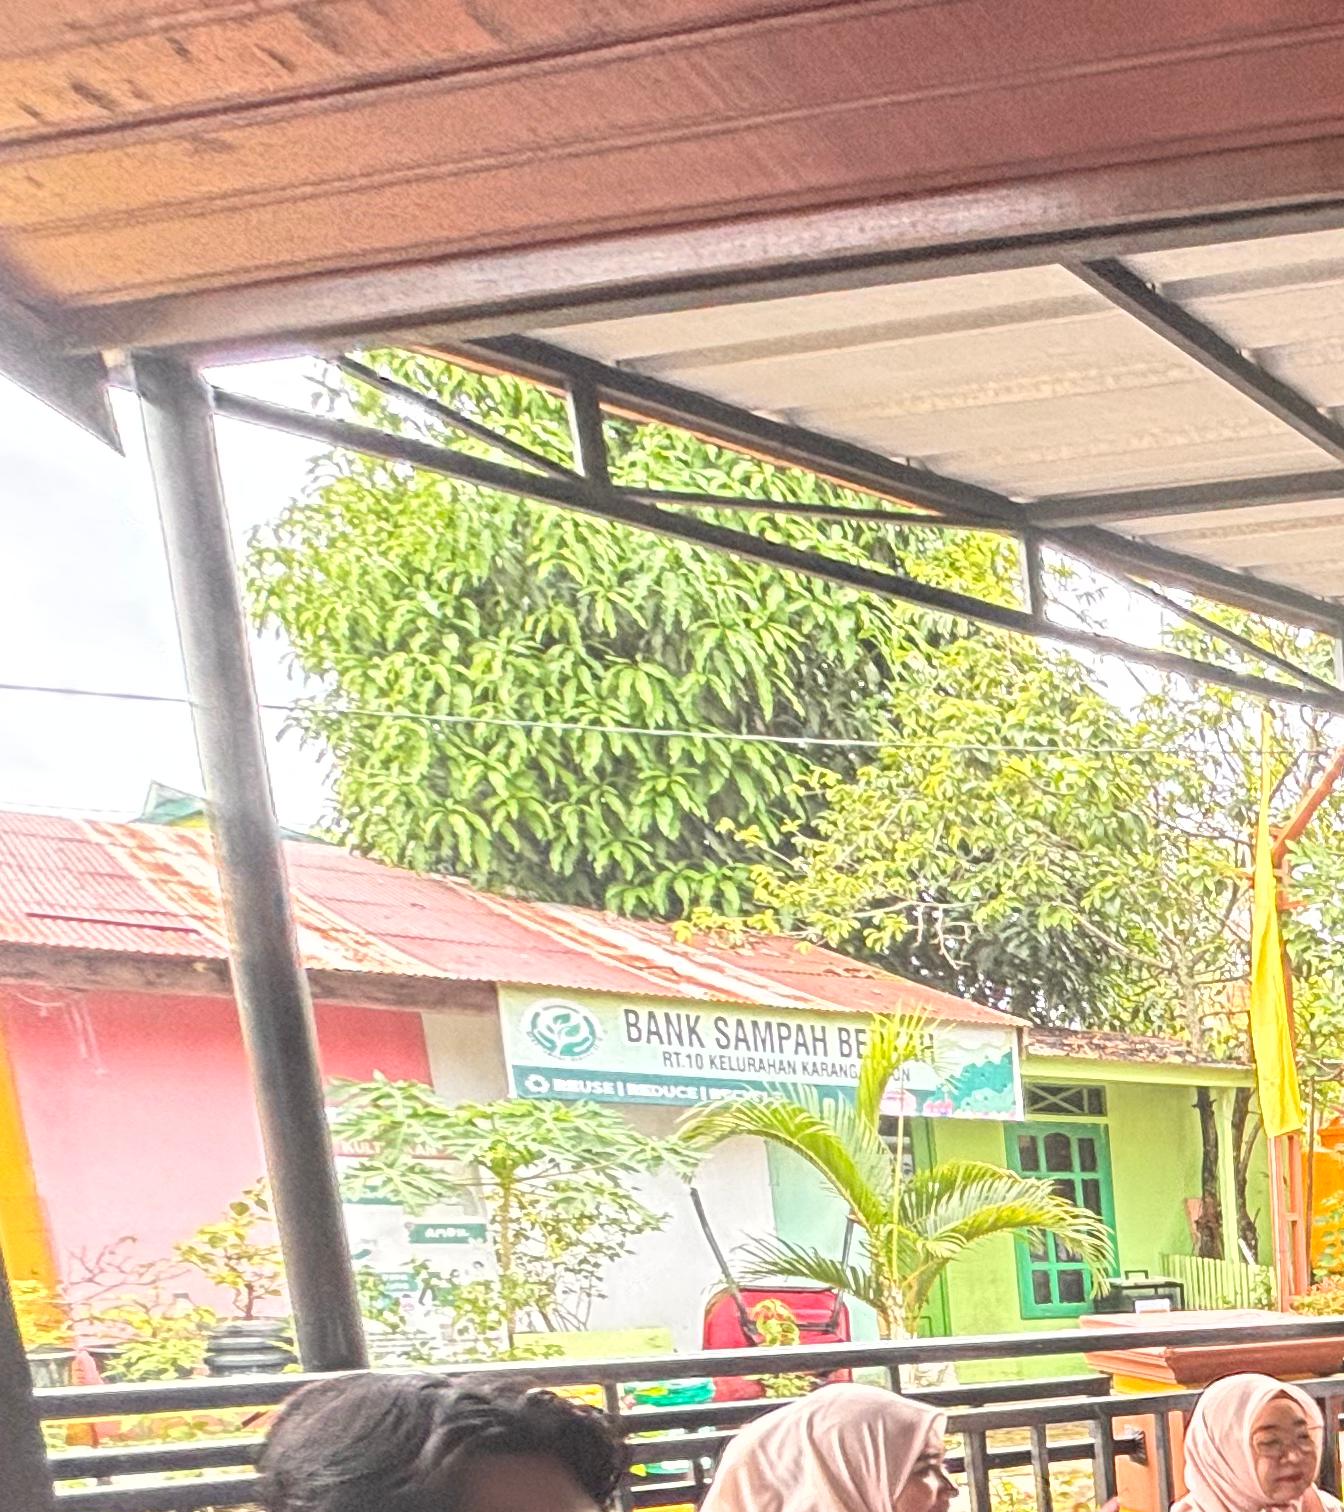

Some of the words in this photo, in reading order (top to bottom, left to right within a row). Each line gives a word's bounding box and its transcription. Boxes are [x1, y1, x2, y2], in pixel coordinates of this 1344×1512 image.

[624, 1008, 705, 1049] BANK
[714, 1015, 828, 1058] SAMPAH
[663, 1050, 704, 1070] RT.10
[709, 1054, 797, 1075] KELURAHAN
[802, 1061, 858, 1079] KARANG
